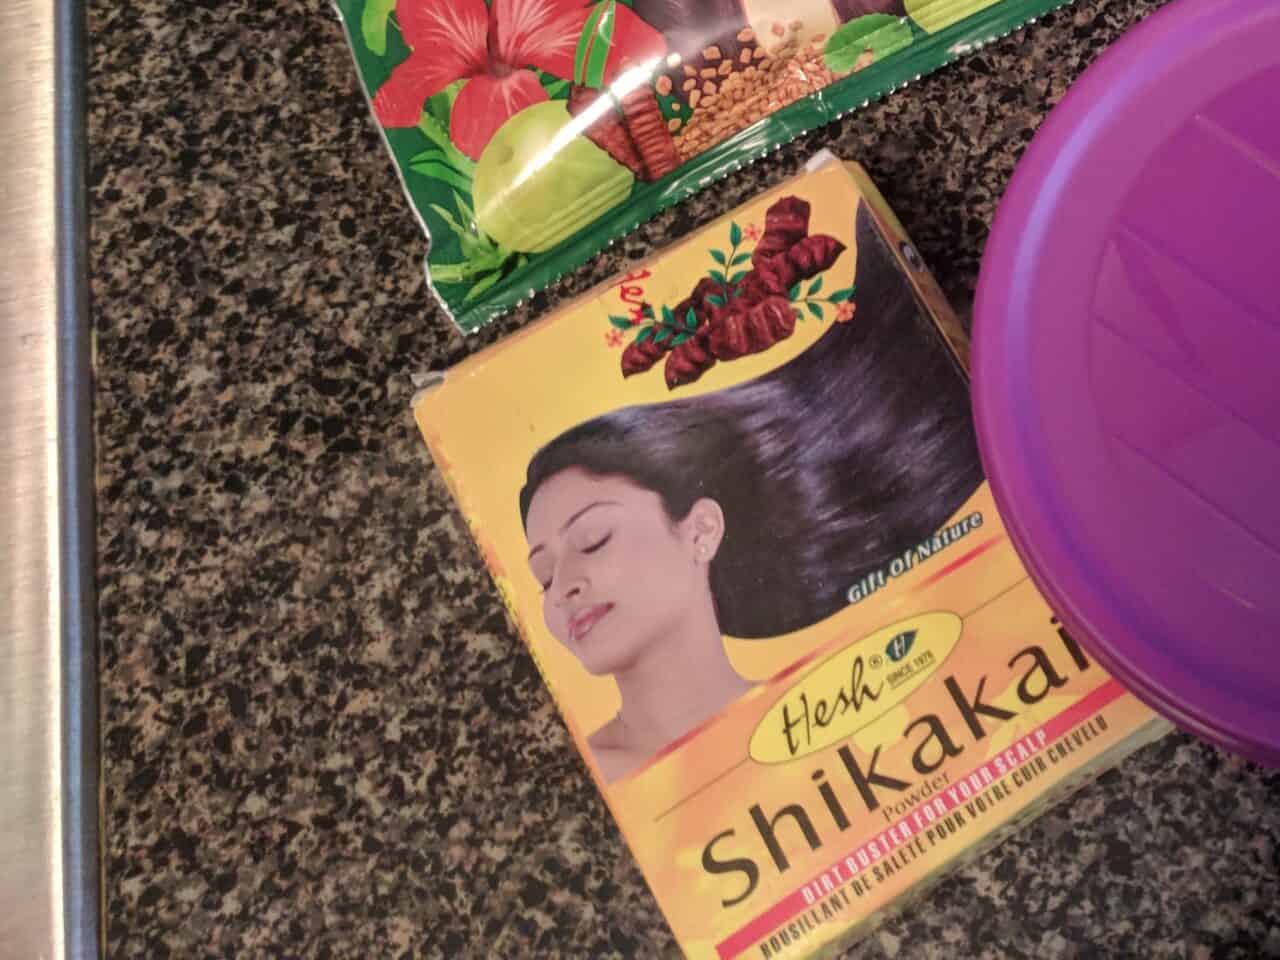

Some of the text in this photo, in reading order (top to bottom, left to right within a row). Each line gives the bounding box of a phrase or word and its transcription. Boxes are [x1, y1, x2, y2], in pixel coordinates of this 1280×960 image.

[847, 511, 984, 604] Gift Of Nature
[700, 616, 1092, 909] Shikakai
[781, 655, 885, 756] Hesh
[801, 728, 1048, 906] DIRT BUSTER FOR YOUR SCALP
[851, 873, 873, 897] DE
[925, 810, 967, 847] POUR
[966, 780, 1013, 820] VOTRE
[1011, 755, 1048, 789] CUIR
[1047, 713, 1109, 763] CHEVELU
[881, 771, 954, 824] Powder
